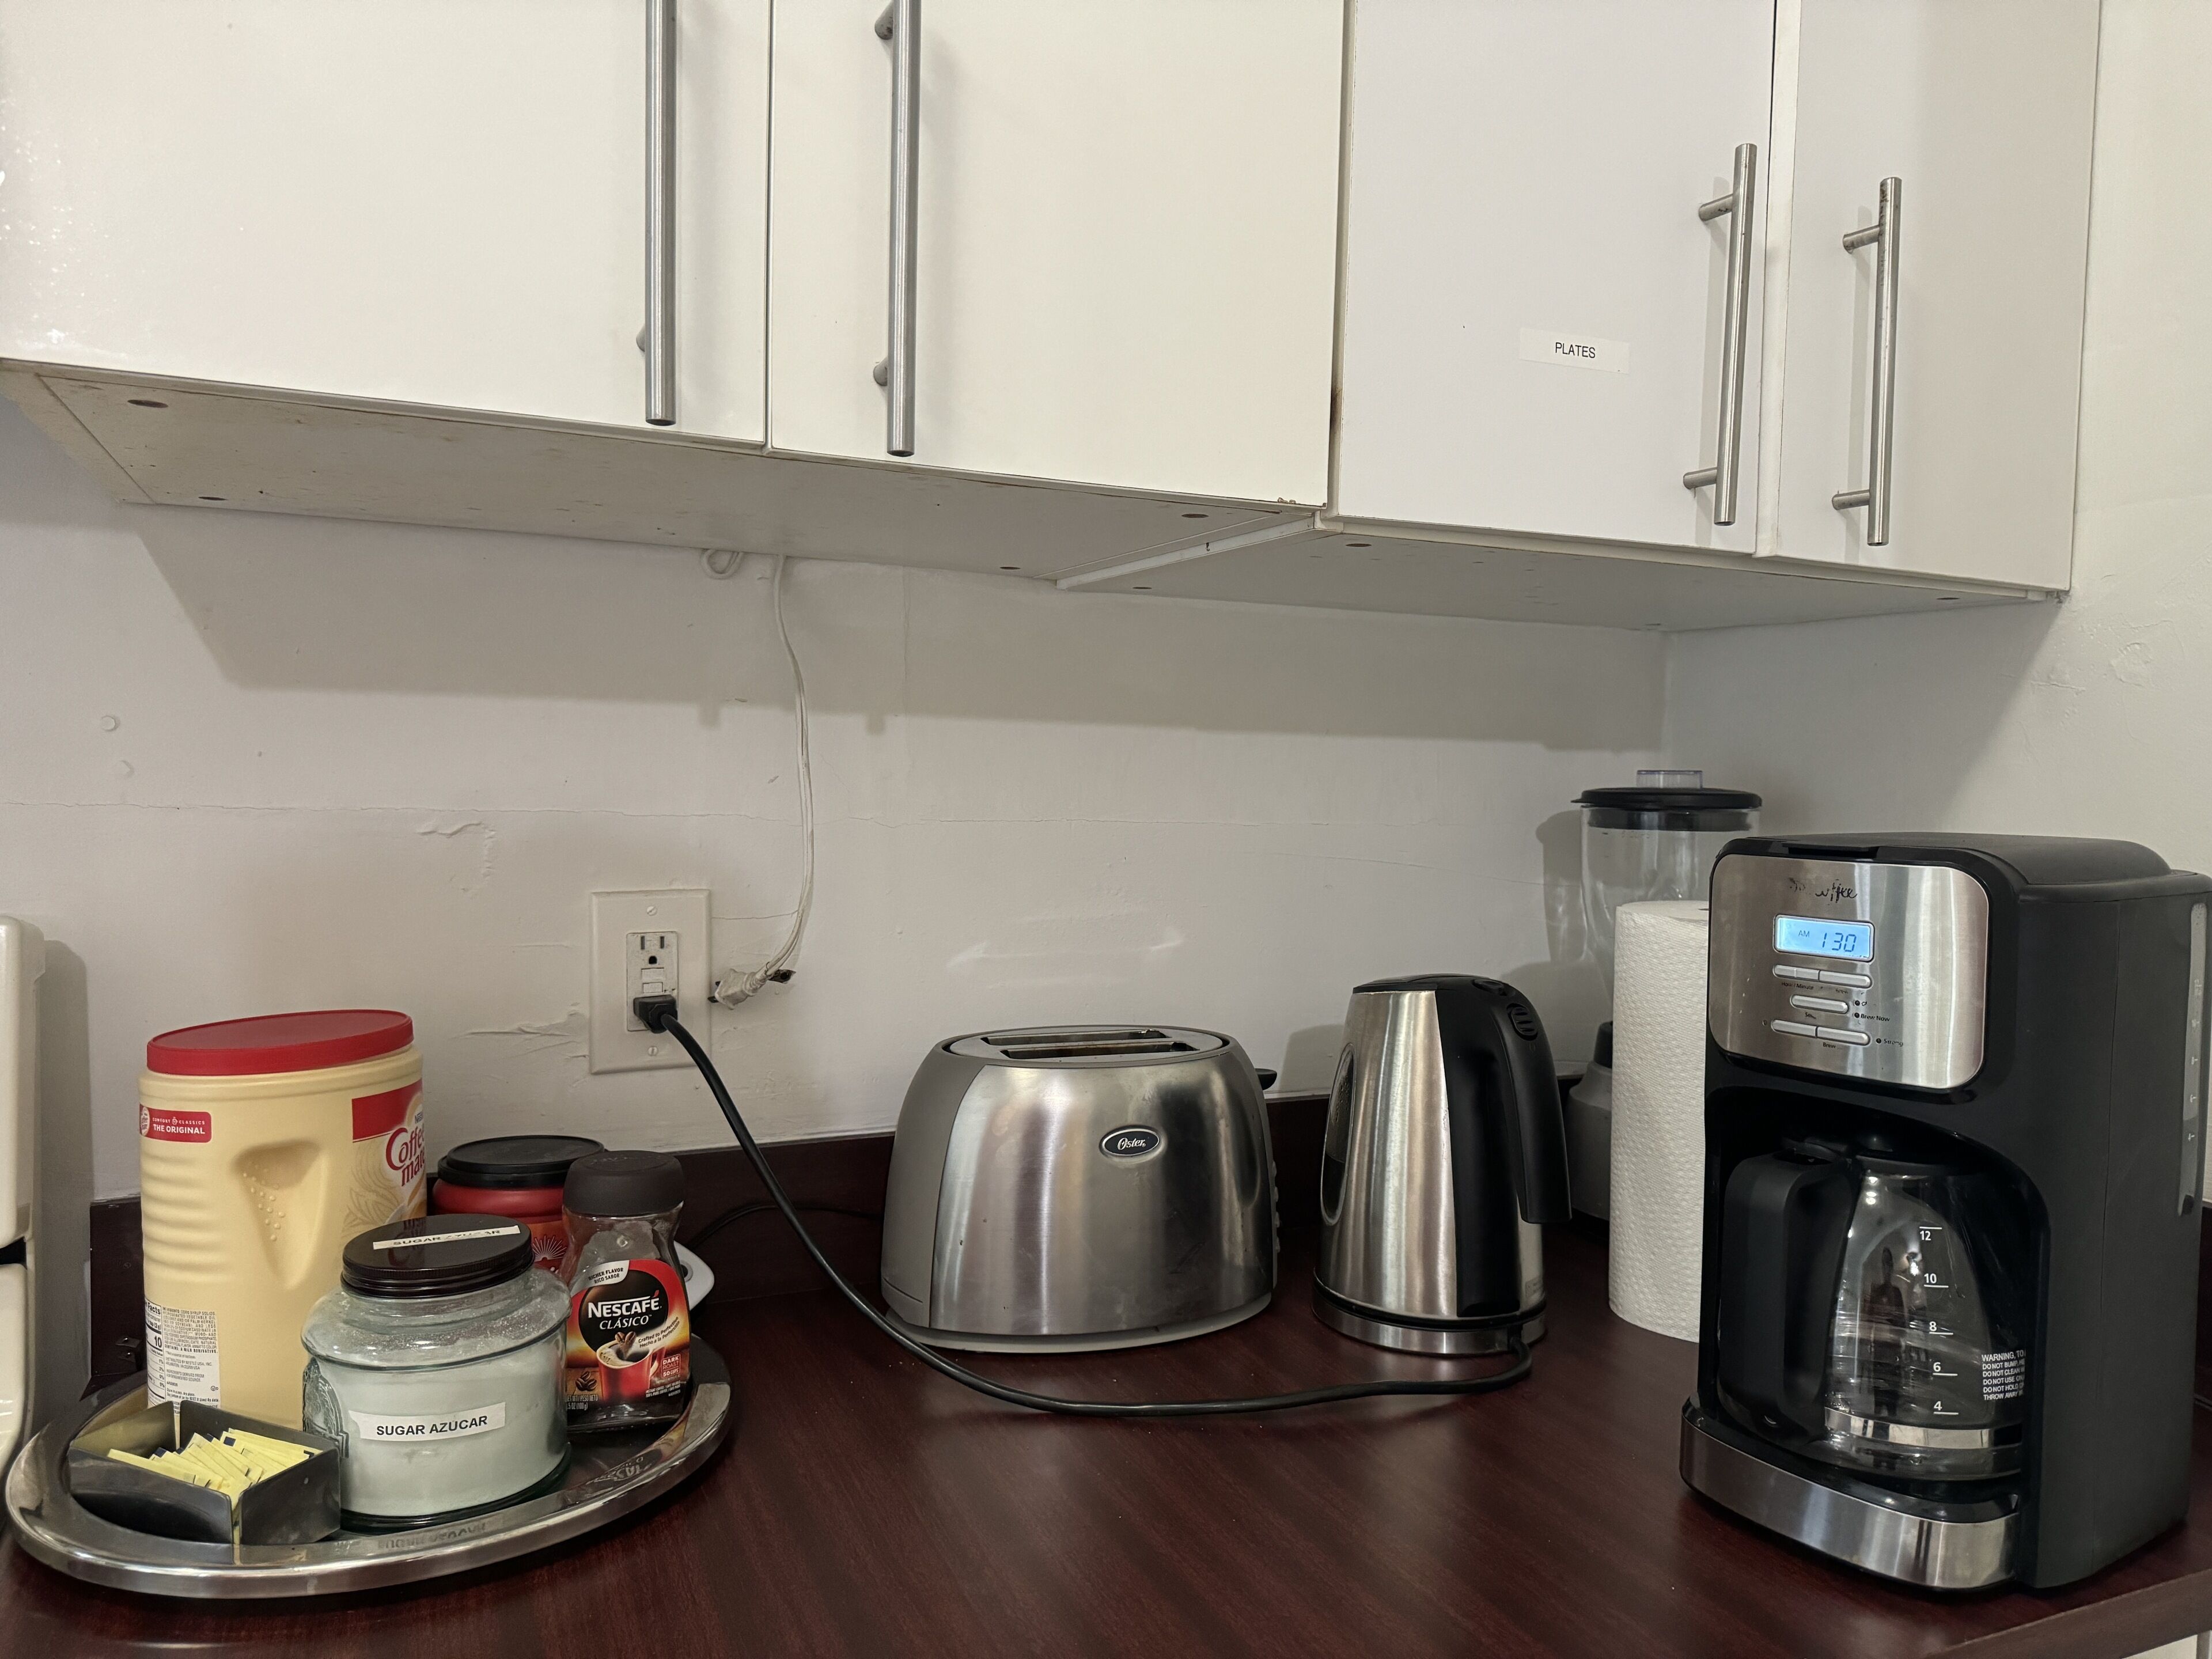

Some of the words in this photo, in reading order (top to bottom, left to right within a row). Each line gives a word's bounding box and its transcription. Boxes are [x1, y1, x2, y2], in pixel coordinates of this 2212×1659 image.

[1555, 342, 1596, 358] PLATES
[153, 1124, 171, 1132] THE
[172, 1126, 205, 1134] ORIGINAL
[1118, 1137, 1145, 1150] Oster
[1919, 1230, 1931, 1241] 12
[393, 1237, 441, 1245] SUGAR
[588, 1271, 605, 1281] RICHER
[605, 1267, 624, 1275] FLAVOR
[605, 1273, 620, 1281] SABOR
[1924, 1273, 1937, 1283] 10
[147, 1302, 161, 1315] Facts
[588, 1290, 660, 1318] NESCAFÉ
[599, 1316, 649, 1330] CLÁSICO
[1929, 1321, 1937, 1332] 8
[638, 1334, 655, 1343] Crafted
[661, 1316, 679, 1336] Perfection
[154, 1335, 162, 1348] 10
[639, 1340, 654, 1349] Hecho
[663, 1355, 679, 1365] DARK
[1982, 1352, 2016, 1362] WARNING,
[2016, 1350, 2024, 1358] TO
[663, 1361, 679, 1370] ROAST
[1933, 1362, 1941, 1372] 6
[2005, 1383, 2018, 1391] HOLD
[1933, 1401, 1942, 1411] 4
[376, 1425, 425, 1435] SUGAR
